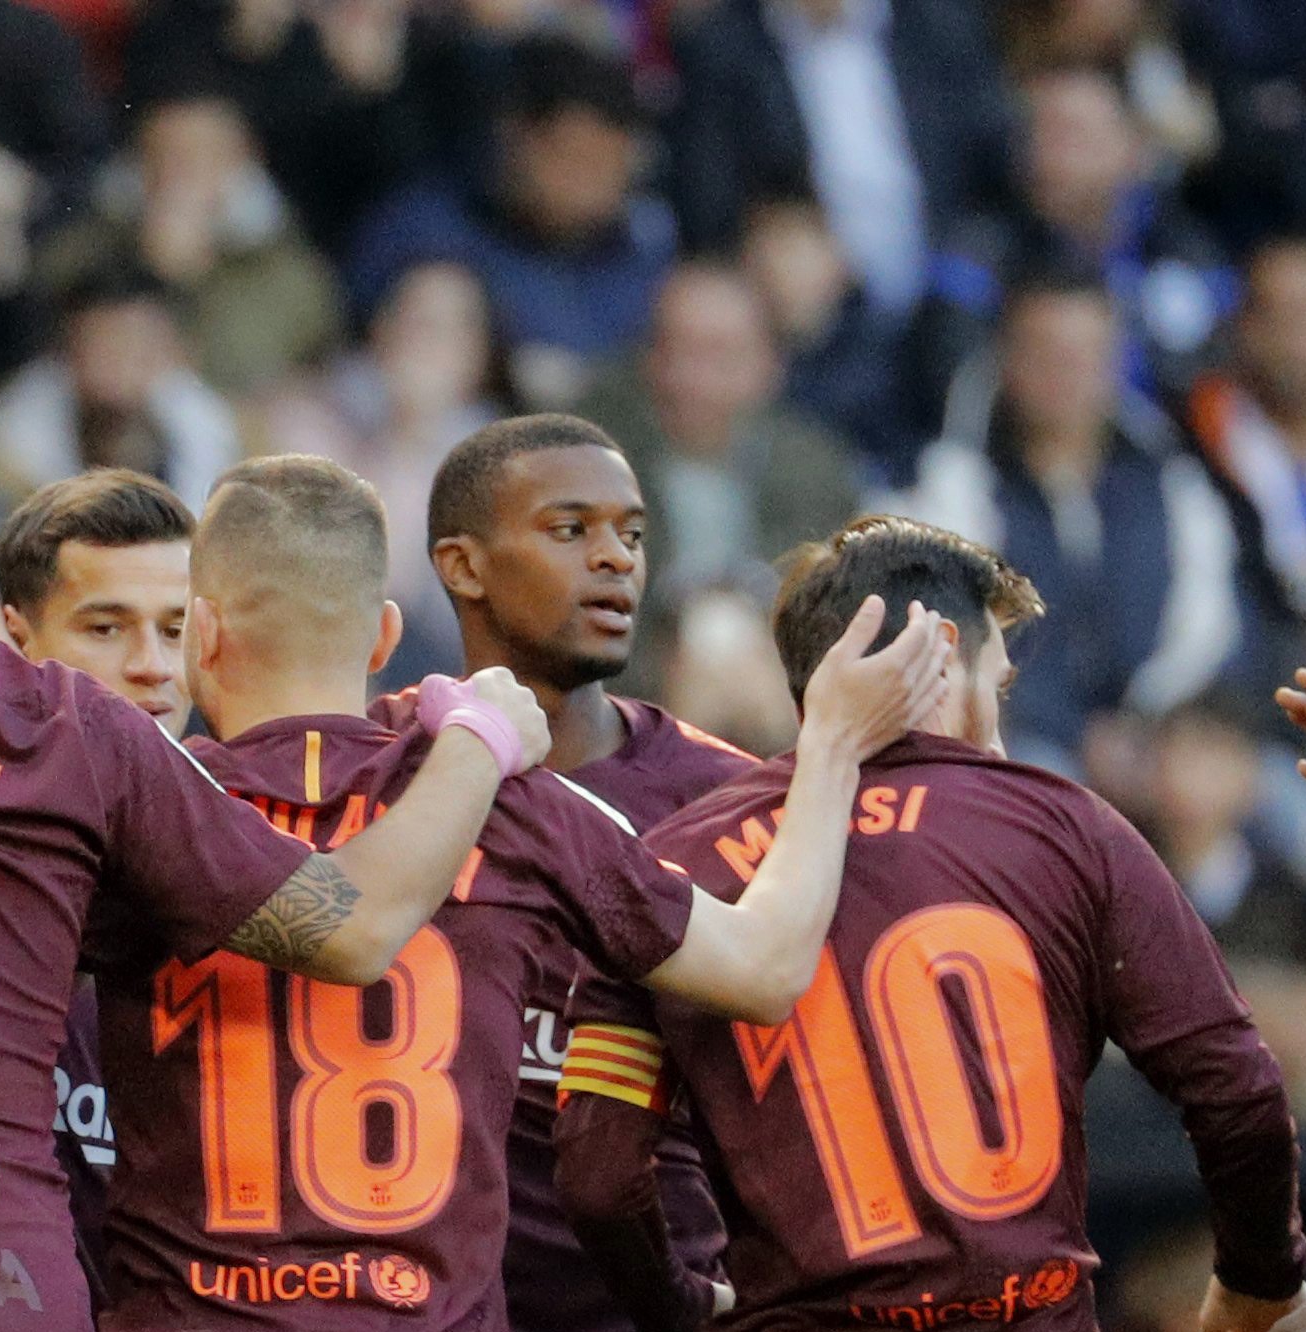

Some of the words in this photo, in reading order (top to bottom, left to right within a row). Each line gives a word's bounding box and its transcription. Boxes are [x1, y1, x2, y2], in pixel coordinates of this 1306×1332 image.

[715, 785, 929, 884] MSI
[150, 922, 464, 1235] 18
[731, 901, 1064, 1260] 10
[189, 1252, 361, 1303] unicef
